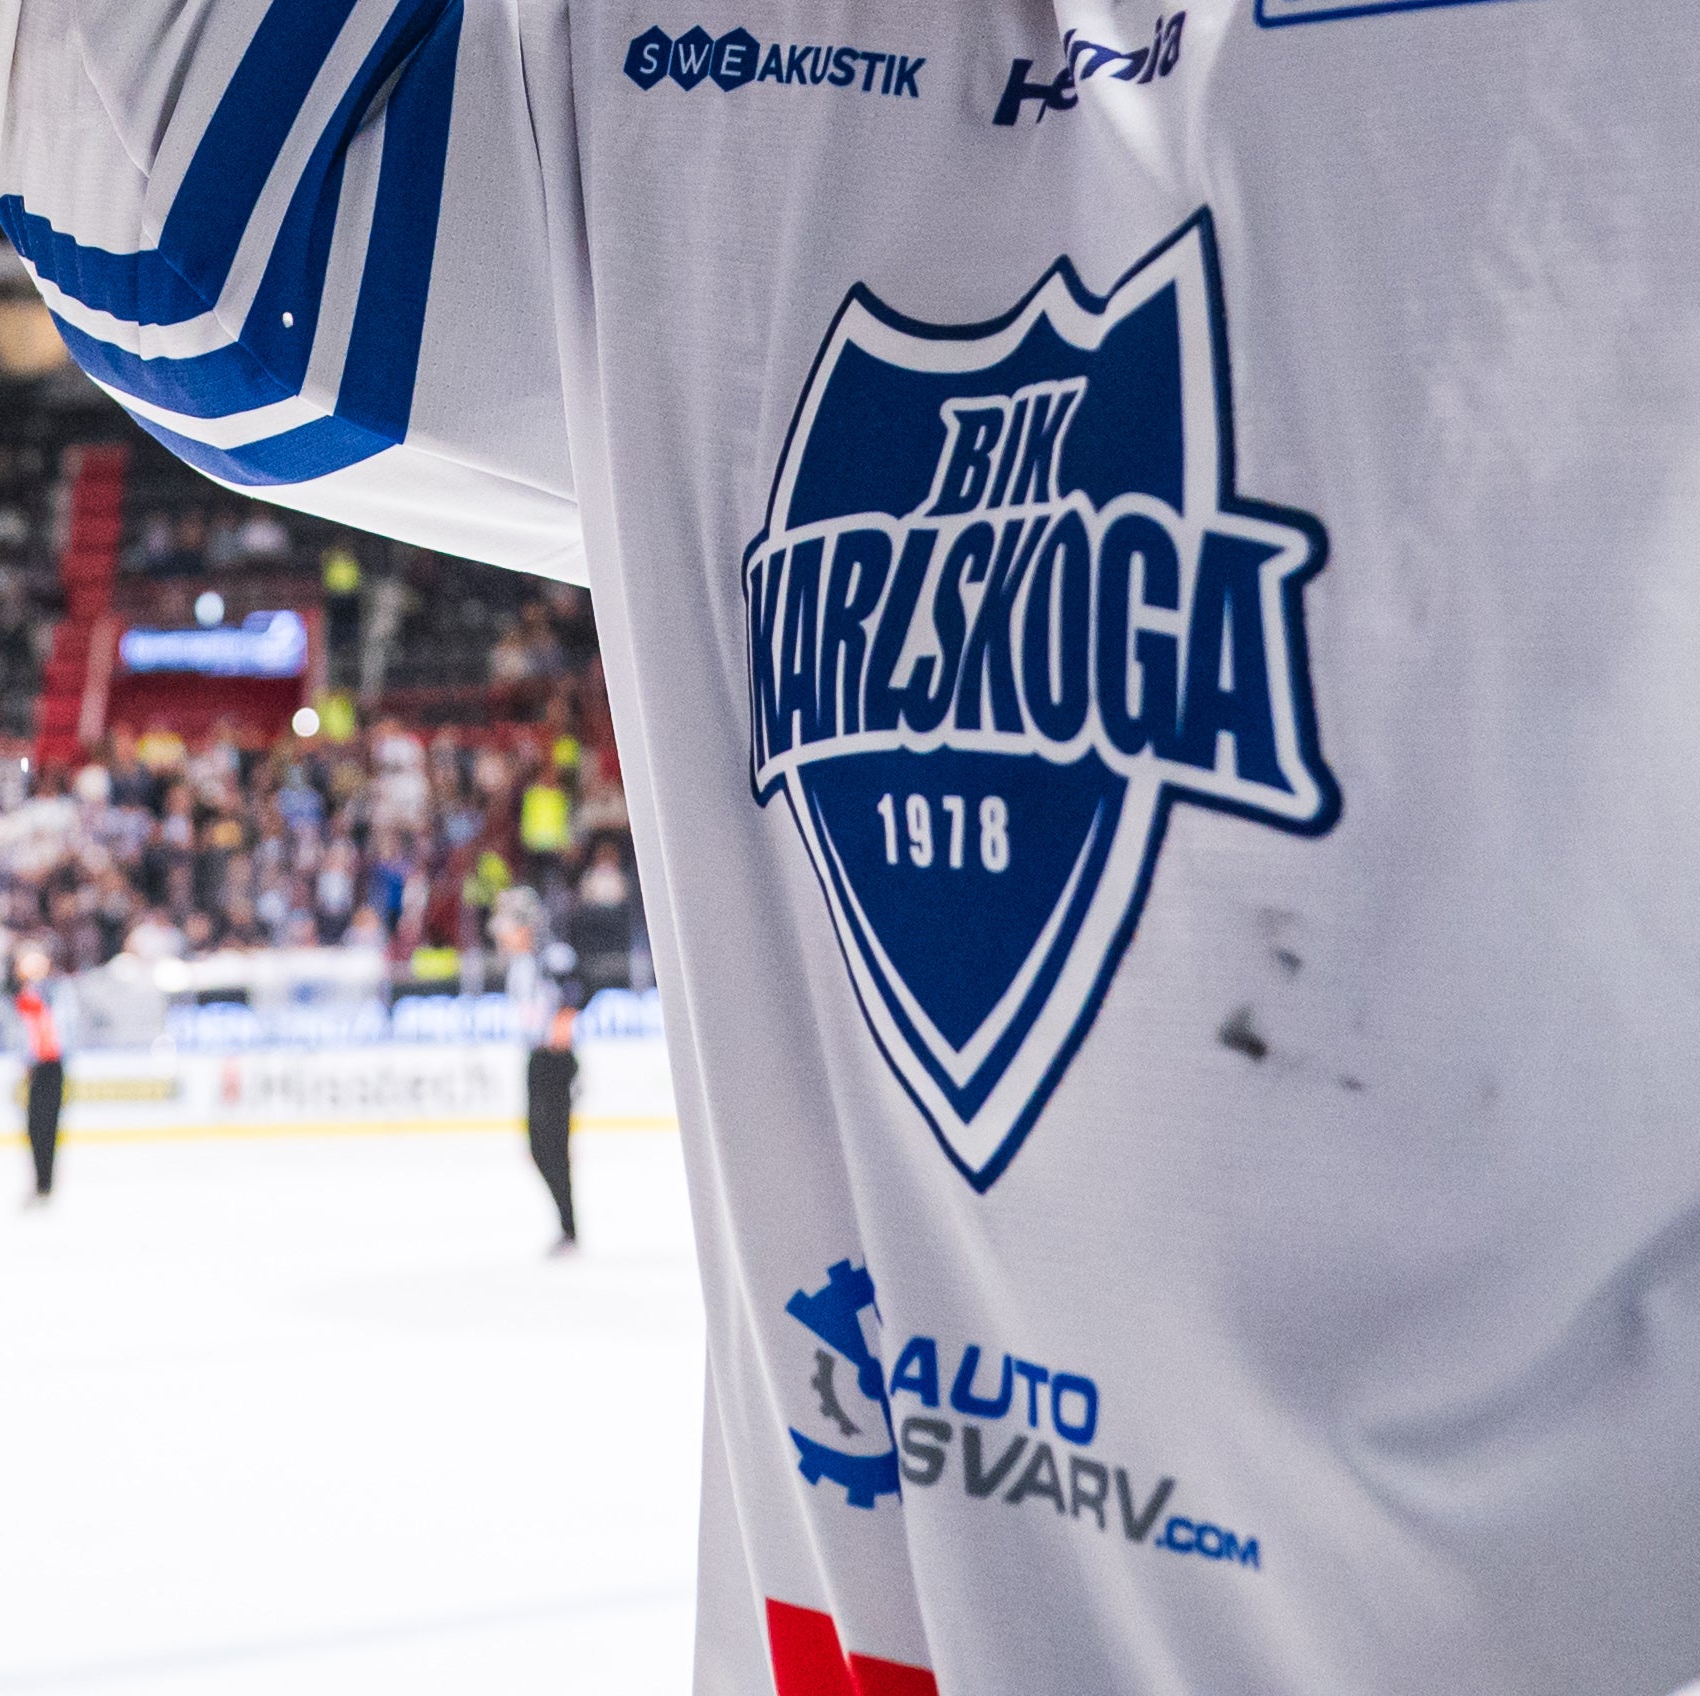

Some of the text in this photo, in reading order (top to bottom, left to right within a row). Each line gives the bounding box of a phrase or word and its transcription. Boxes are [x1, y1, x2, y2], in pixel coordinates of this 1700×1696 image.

[756, 41, 928, 99] AKUSTIK
[925, 380, 1085, 517] BIK
[748, 506, 1297, 795] KARLSKOGA
[875, 791, 1013, 874] 1978
[889, 1334, 1100, 1448] AUTO
[898, 1415, 1265, 1571] SVARV.COM
